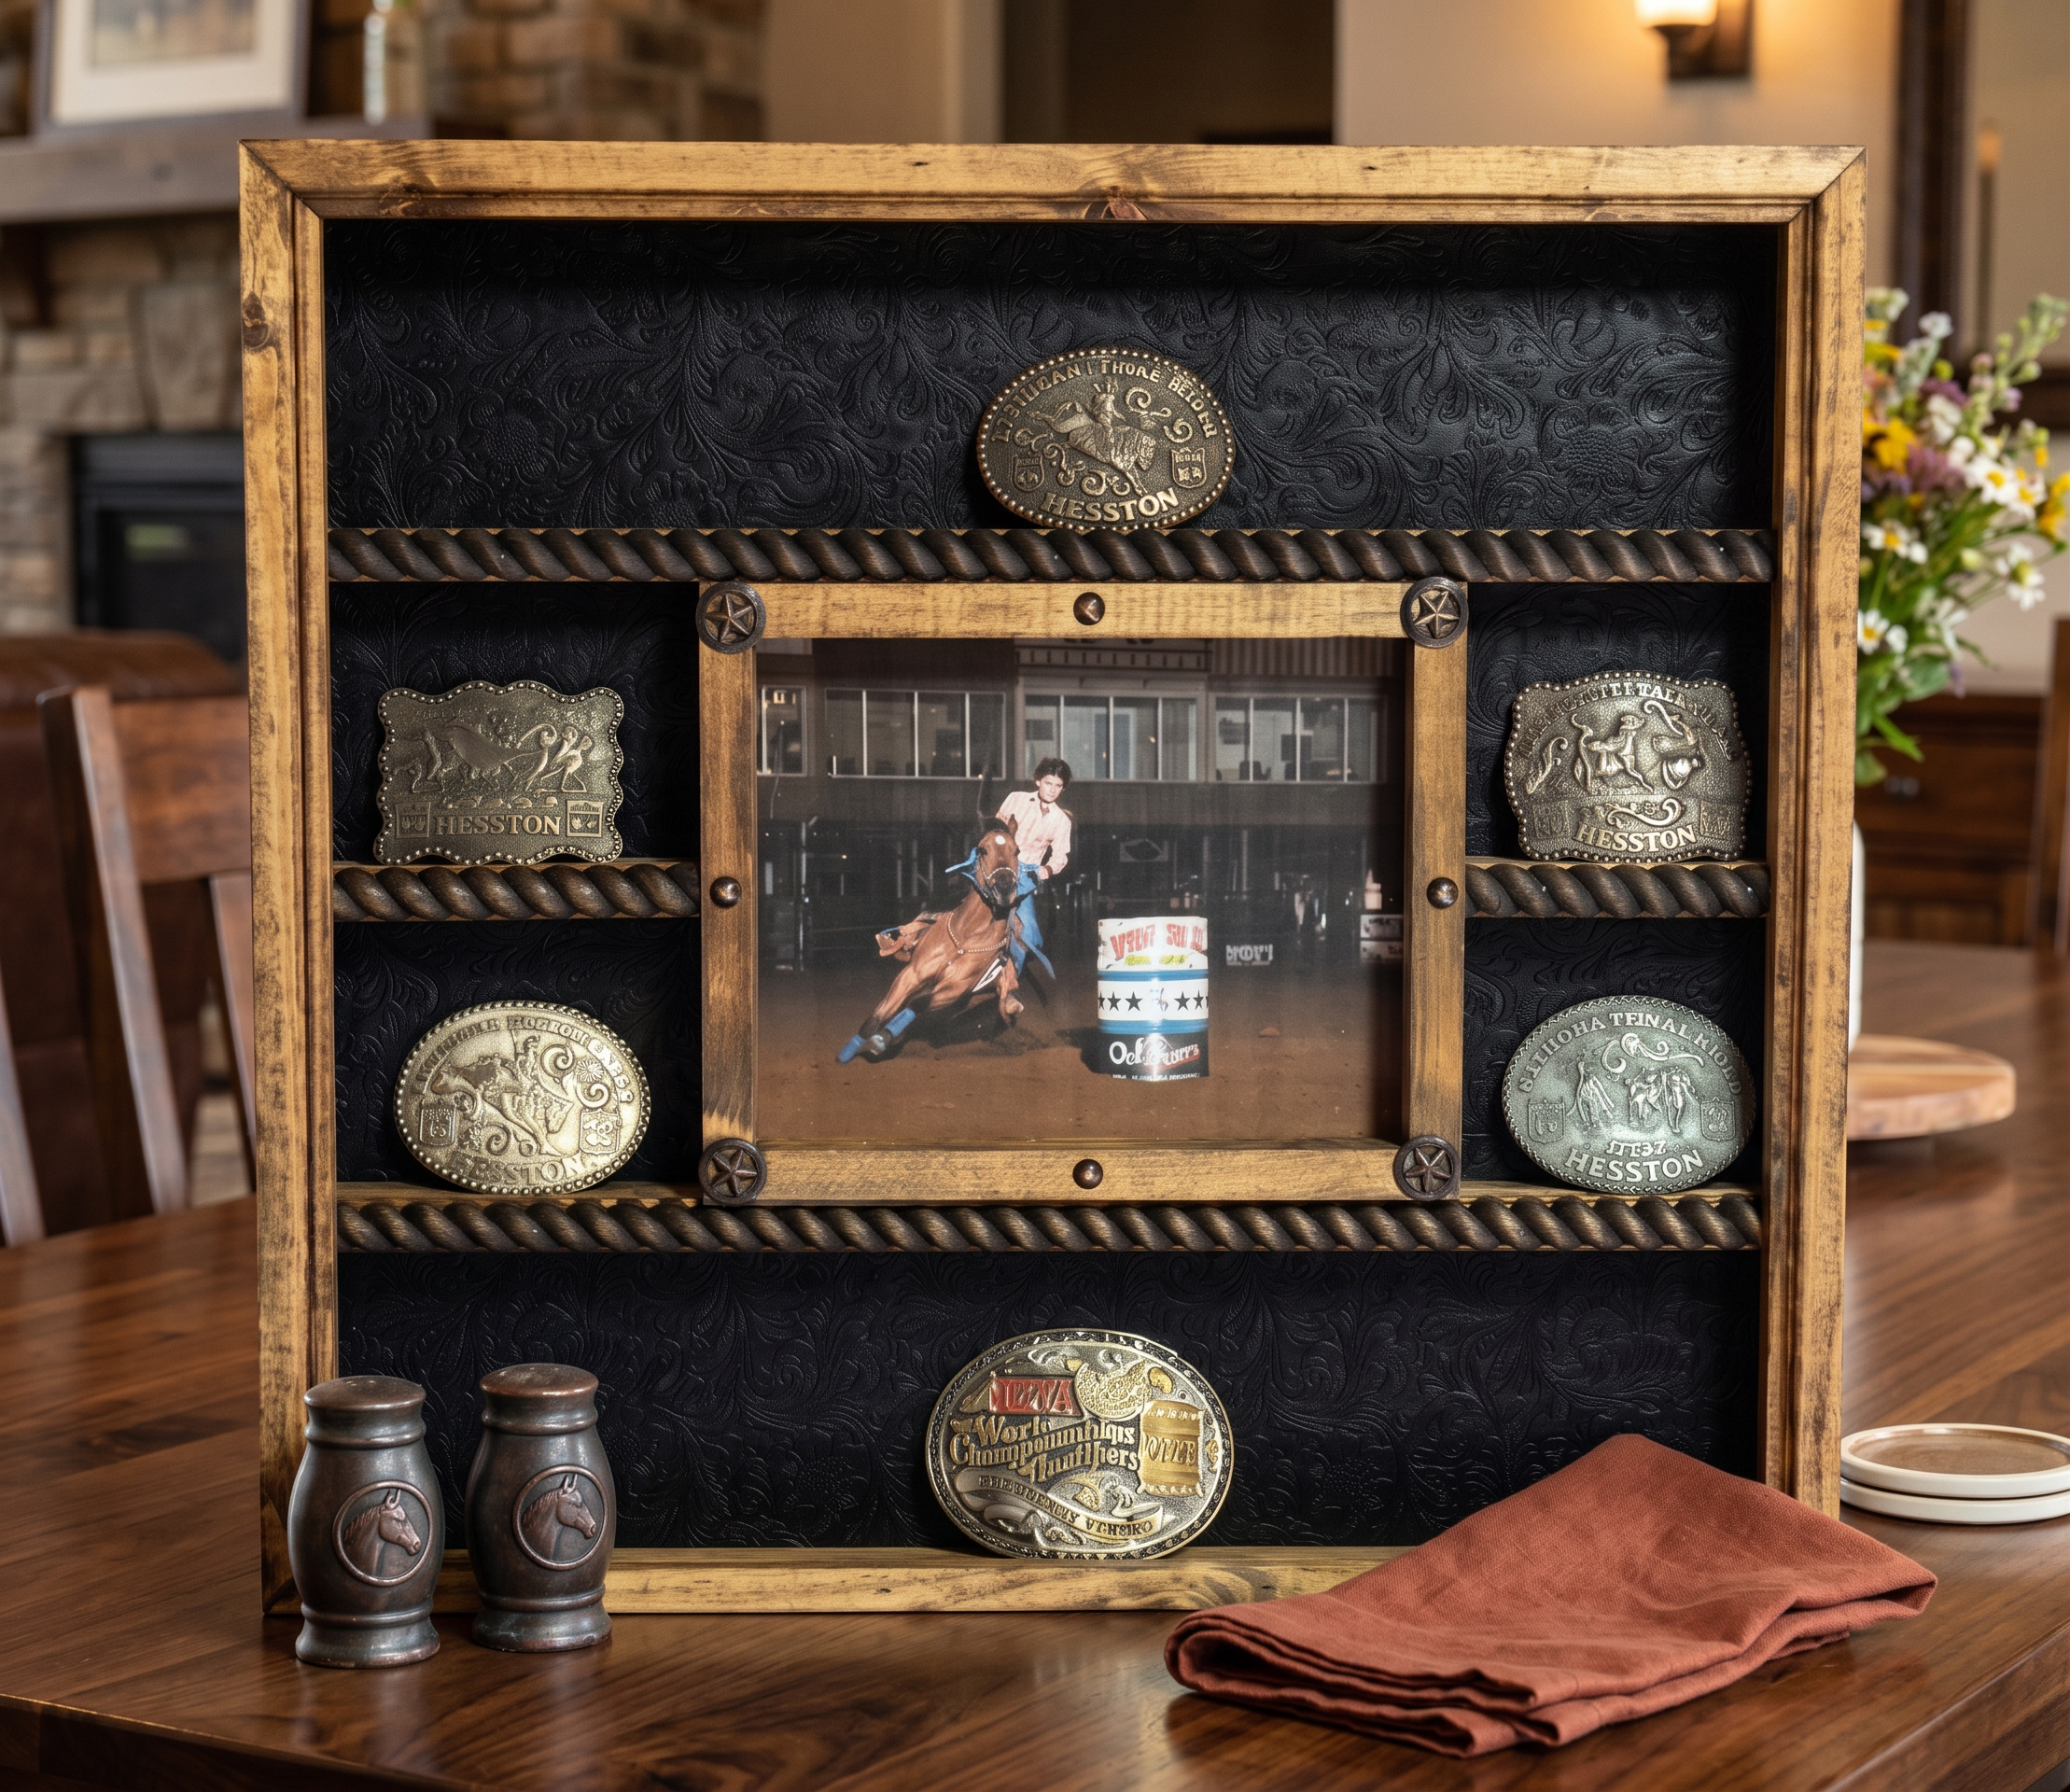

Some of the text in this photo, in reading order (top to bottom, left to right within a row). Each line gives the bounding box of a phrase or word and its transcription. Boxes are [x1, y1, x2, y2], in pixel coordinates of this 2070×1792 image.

[1040, 487, 1180, 523] HESSTON
[434, 814, 561, 836] HESSTON
[1573, 824, 1698, 853] HESSTON
[1565, 1148, 1704, 1183] HESSTON
